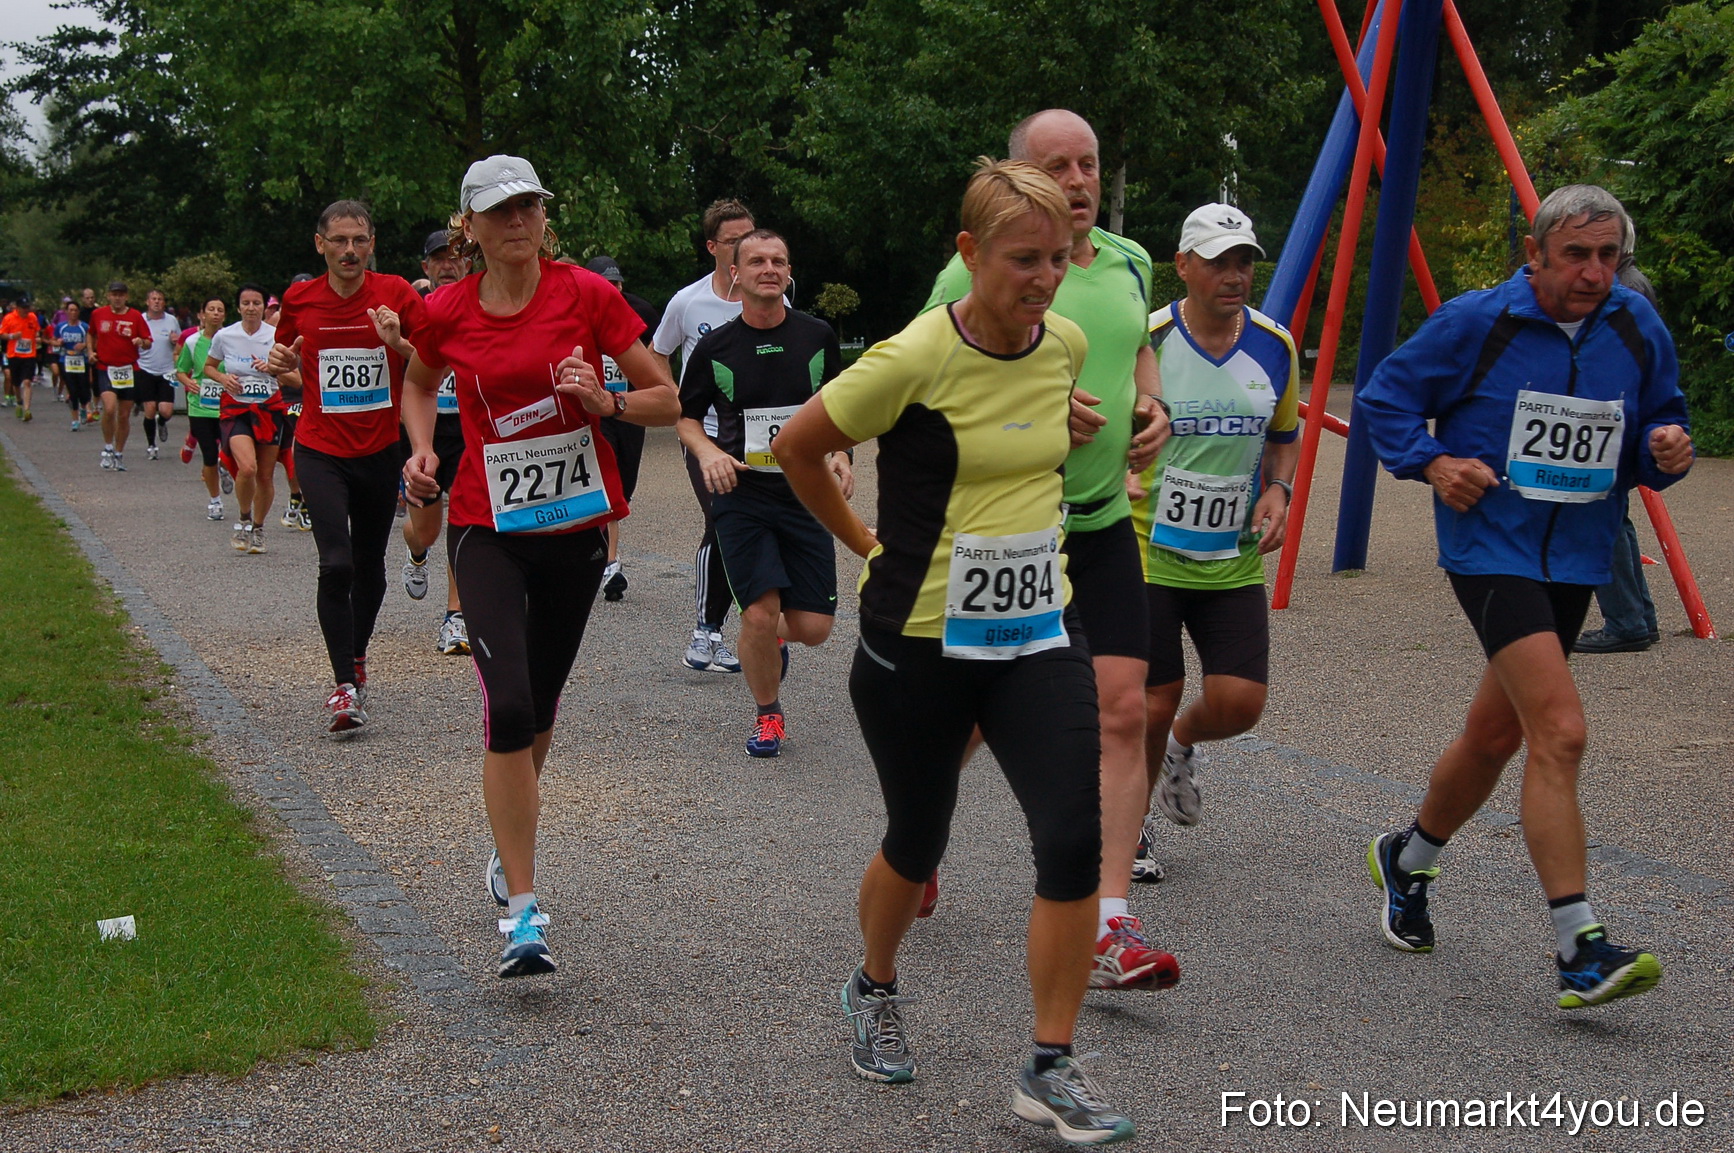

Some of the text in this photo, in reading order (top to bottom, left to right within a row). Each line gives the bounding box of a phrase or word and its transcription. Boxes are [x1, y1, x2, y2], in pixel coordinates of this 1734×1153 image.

[327, 364, 384, 388] 2687
[438, 376, 456, 394] 4
[338, 393, 374, 404] Richard
[1174, 399, 1235, 414] TEAM
[513, 409, 540, 427] DEHN
[1518, 401, 1611, 420] PARTL Neumarkt
[1171, 415, 1267, 437] BOCK
[1521, 419, 1616, 463] 2987
[486, 442, 578, 465] PARTL Neumarkt
[499, 453, 591, 507] 2274
[1164, 475, 1239, 492] PARTL Neumarkt
[1535, 469, 1591, 488] Richard
[535, 504, 569, 525] Gabi
[1166, 491, 1239, 528] 3101
[954, 543, 1048, 560] PARTL Neumarkt
[961, 560, 1055, 613] 2984
[985, 624, 1033, 645] gisela
